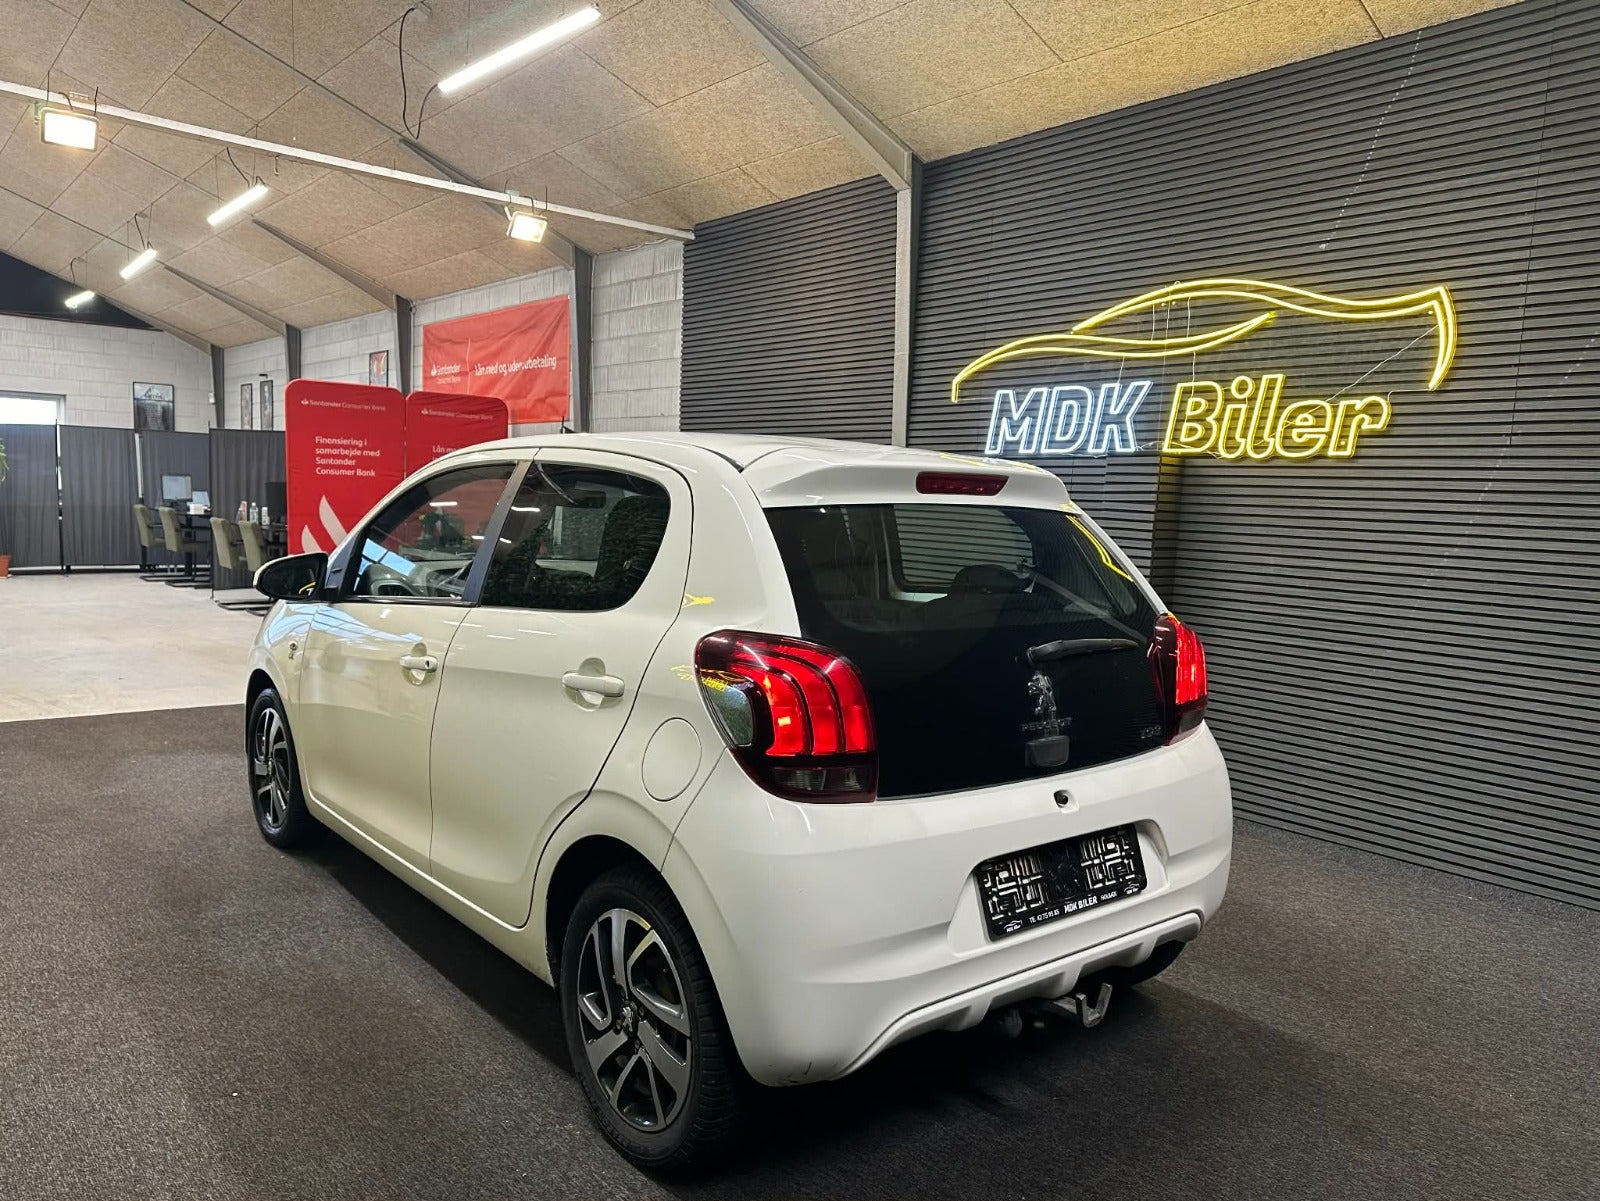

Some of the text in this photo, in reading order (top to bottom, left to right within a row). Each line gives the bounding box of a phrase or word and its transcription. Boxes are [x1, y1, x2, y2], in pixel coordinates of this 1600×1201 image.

[499, 363, 508, 376] og
[310, 399, 341, 408] Santander
[985, 373, 1392, 460] MDK Biler
[315, 436, 363, 447] Finansiering
[315, 448, 380, 457] samarbejde med
[432, 445, 445, 453] Lån
[315, 457, 356, 465] Santander
[316, 467, 376, 477] Consumer Bank
[1078, 896, 1097, 909] BILER
